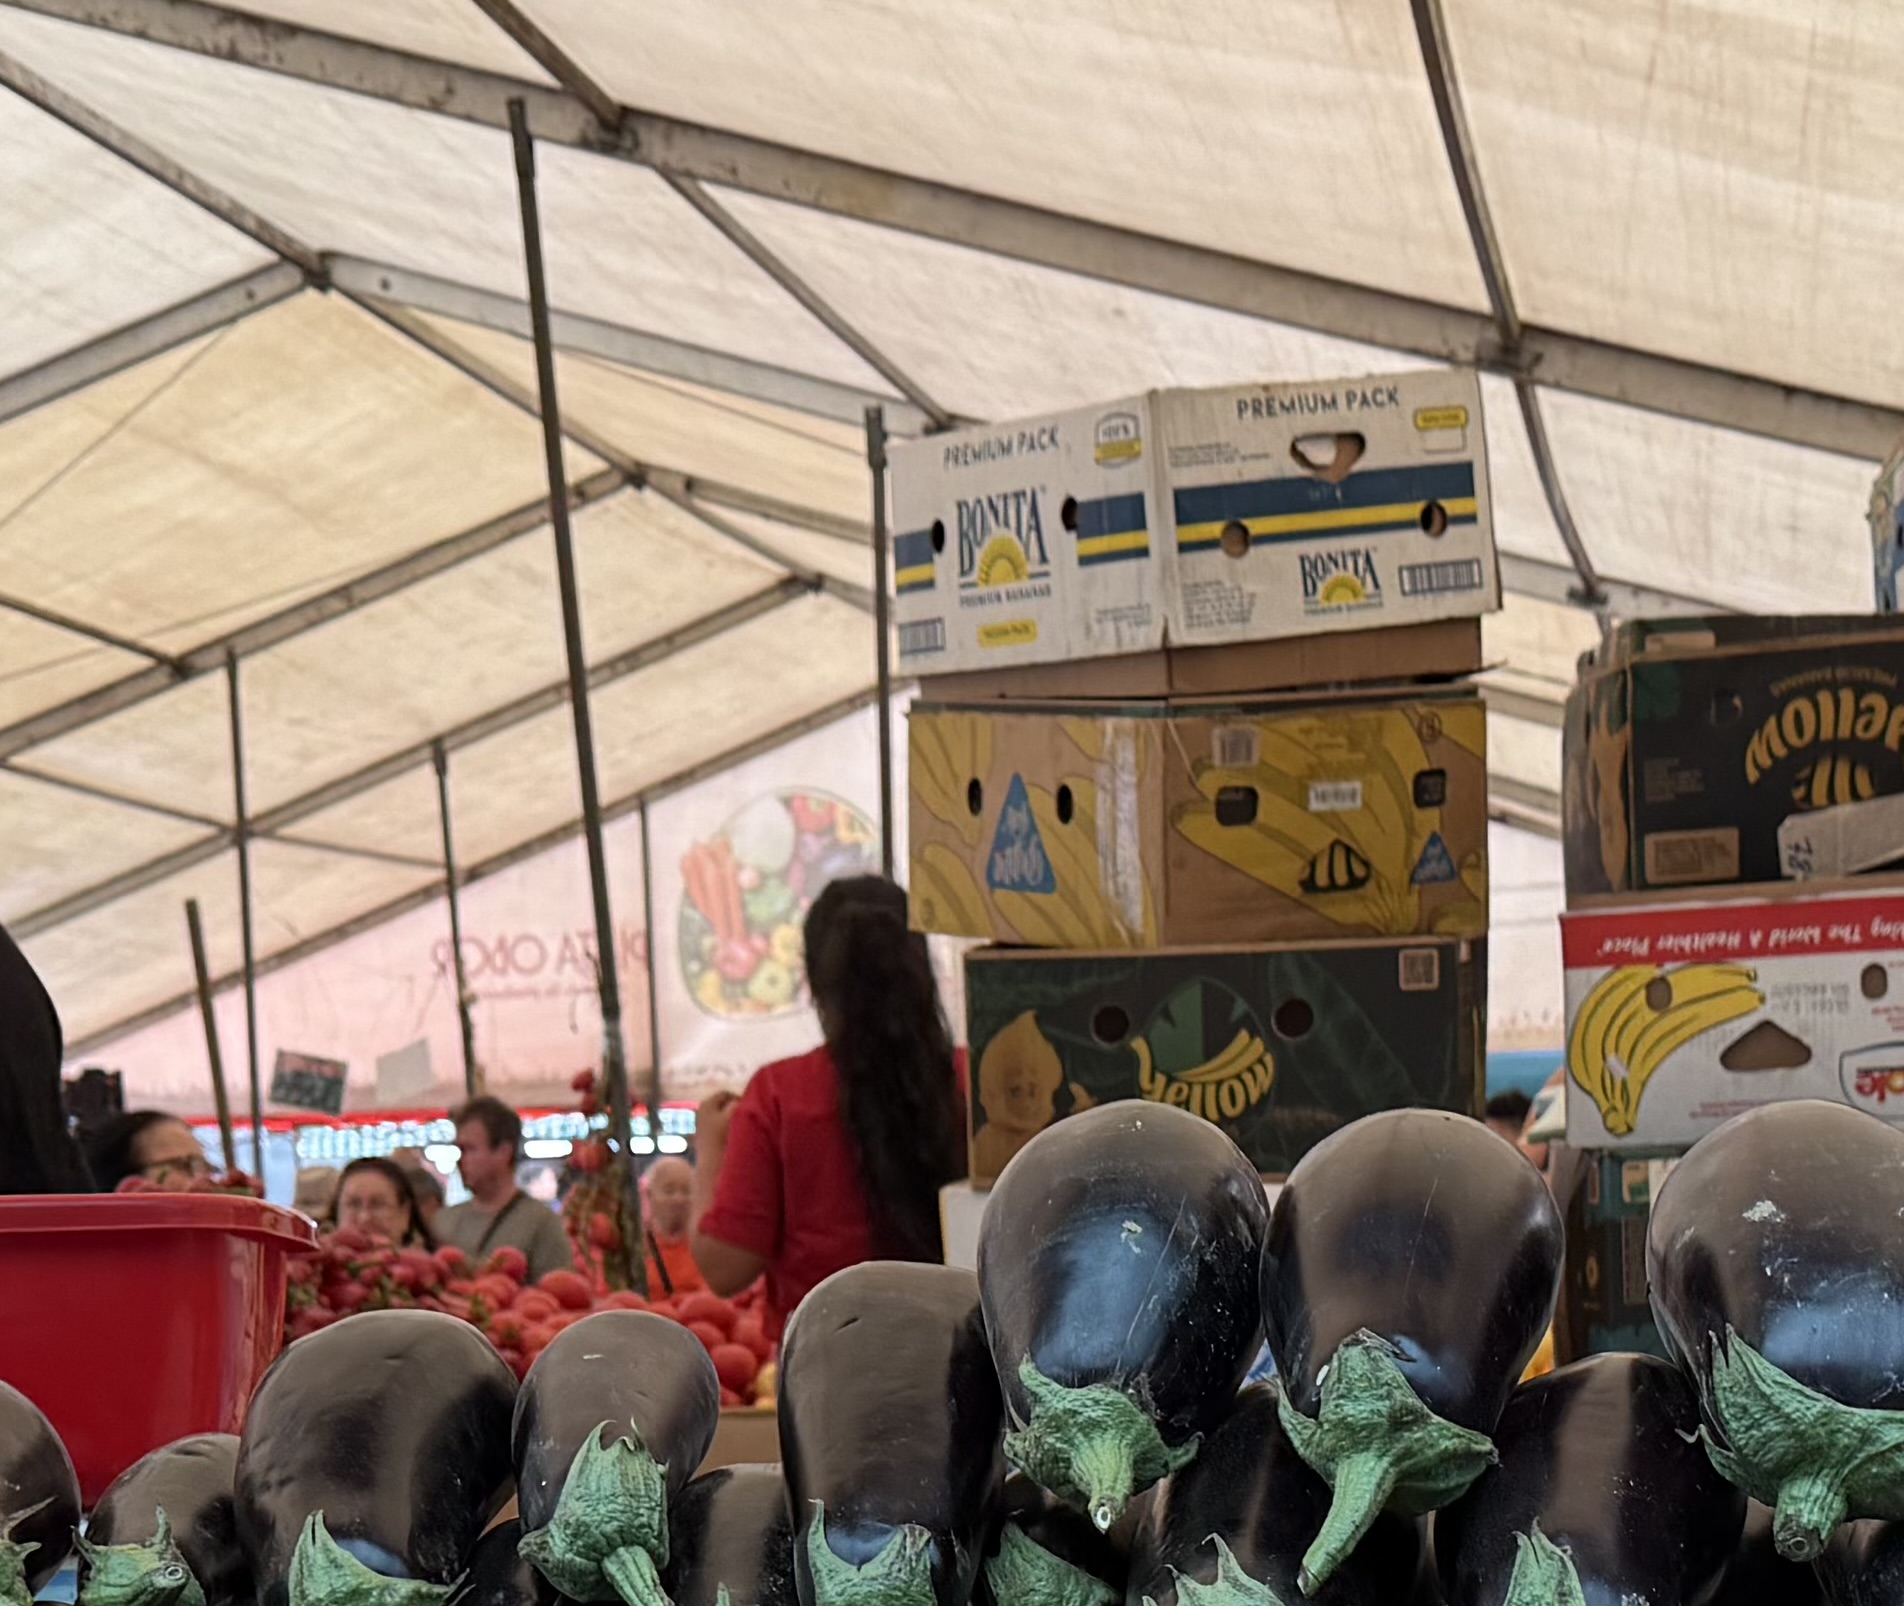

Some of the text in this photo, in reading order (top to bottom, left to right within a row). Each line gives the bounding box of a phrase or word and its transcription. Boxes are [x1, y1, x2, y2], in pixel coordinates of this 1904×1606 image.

[1237, 386, 1400, 420] PREMIUM PACK
[944, 426, 1060, 470] PREMIUM PACK
[956, 486, 1049, 577] BONITA
[1299, 548, 1381, 598] BONITA
[1602, 936, 1650, 955] Place
[1656, 930, 1741, 955] Healthier
[1769, 925, 1822, 949] World
[1828, 924, 1861, 943] The
